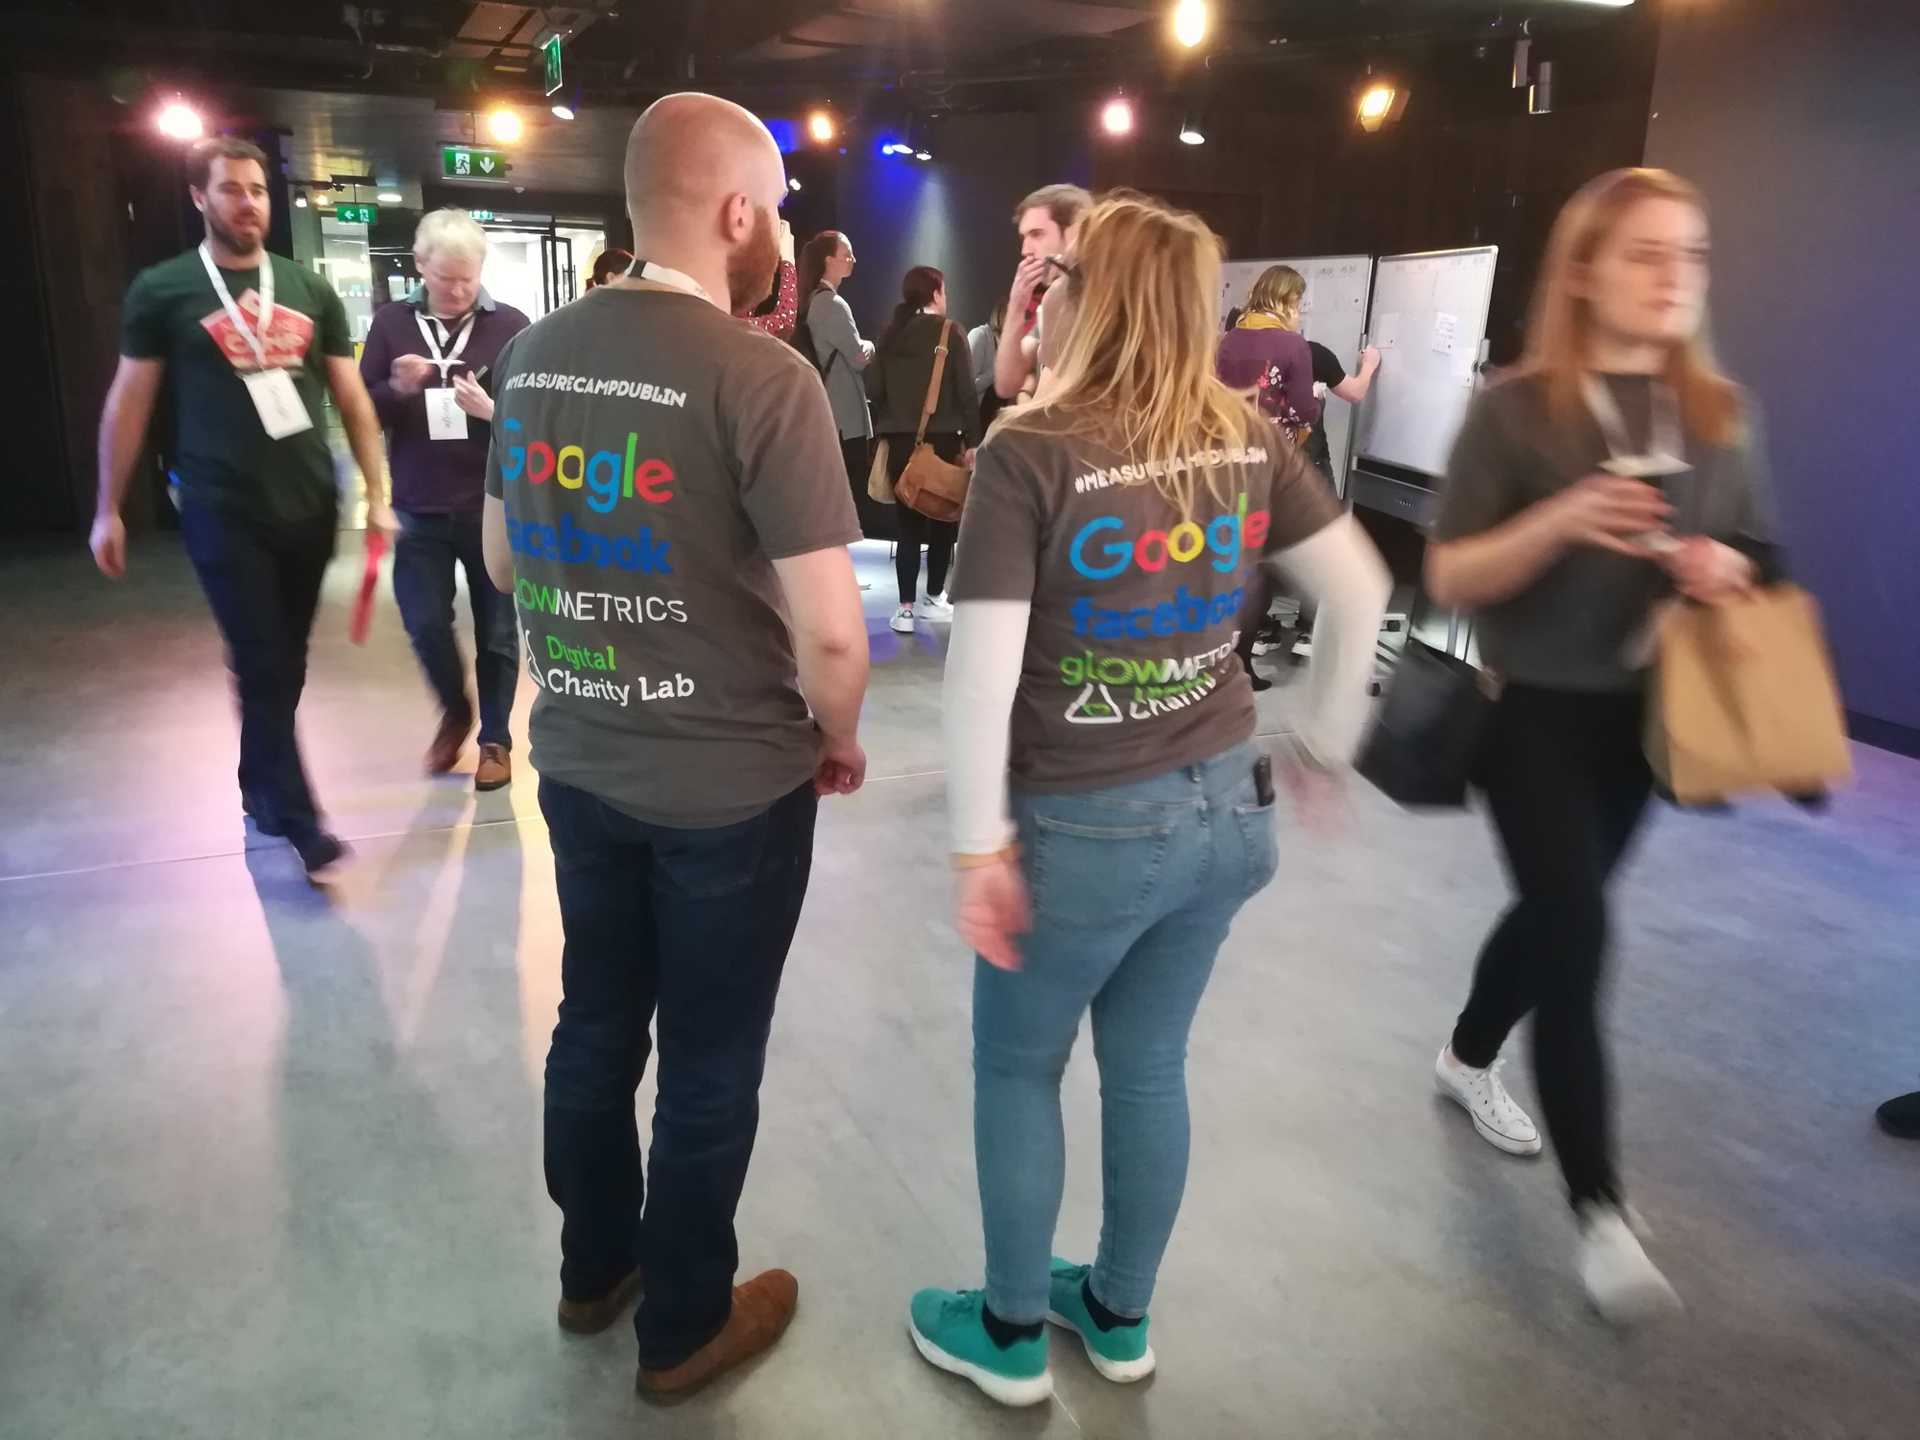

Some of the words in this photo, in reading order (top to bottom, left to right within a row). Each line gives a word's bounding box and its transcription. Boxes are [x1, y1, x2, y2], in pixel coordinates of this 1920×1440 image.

[501, 417, 676, 513] Google
[545, 634, 617, 672] Digital
[547, 668, 631, 707] Charity
[638, 673, 695, 701] Lab
